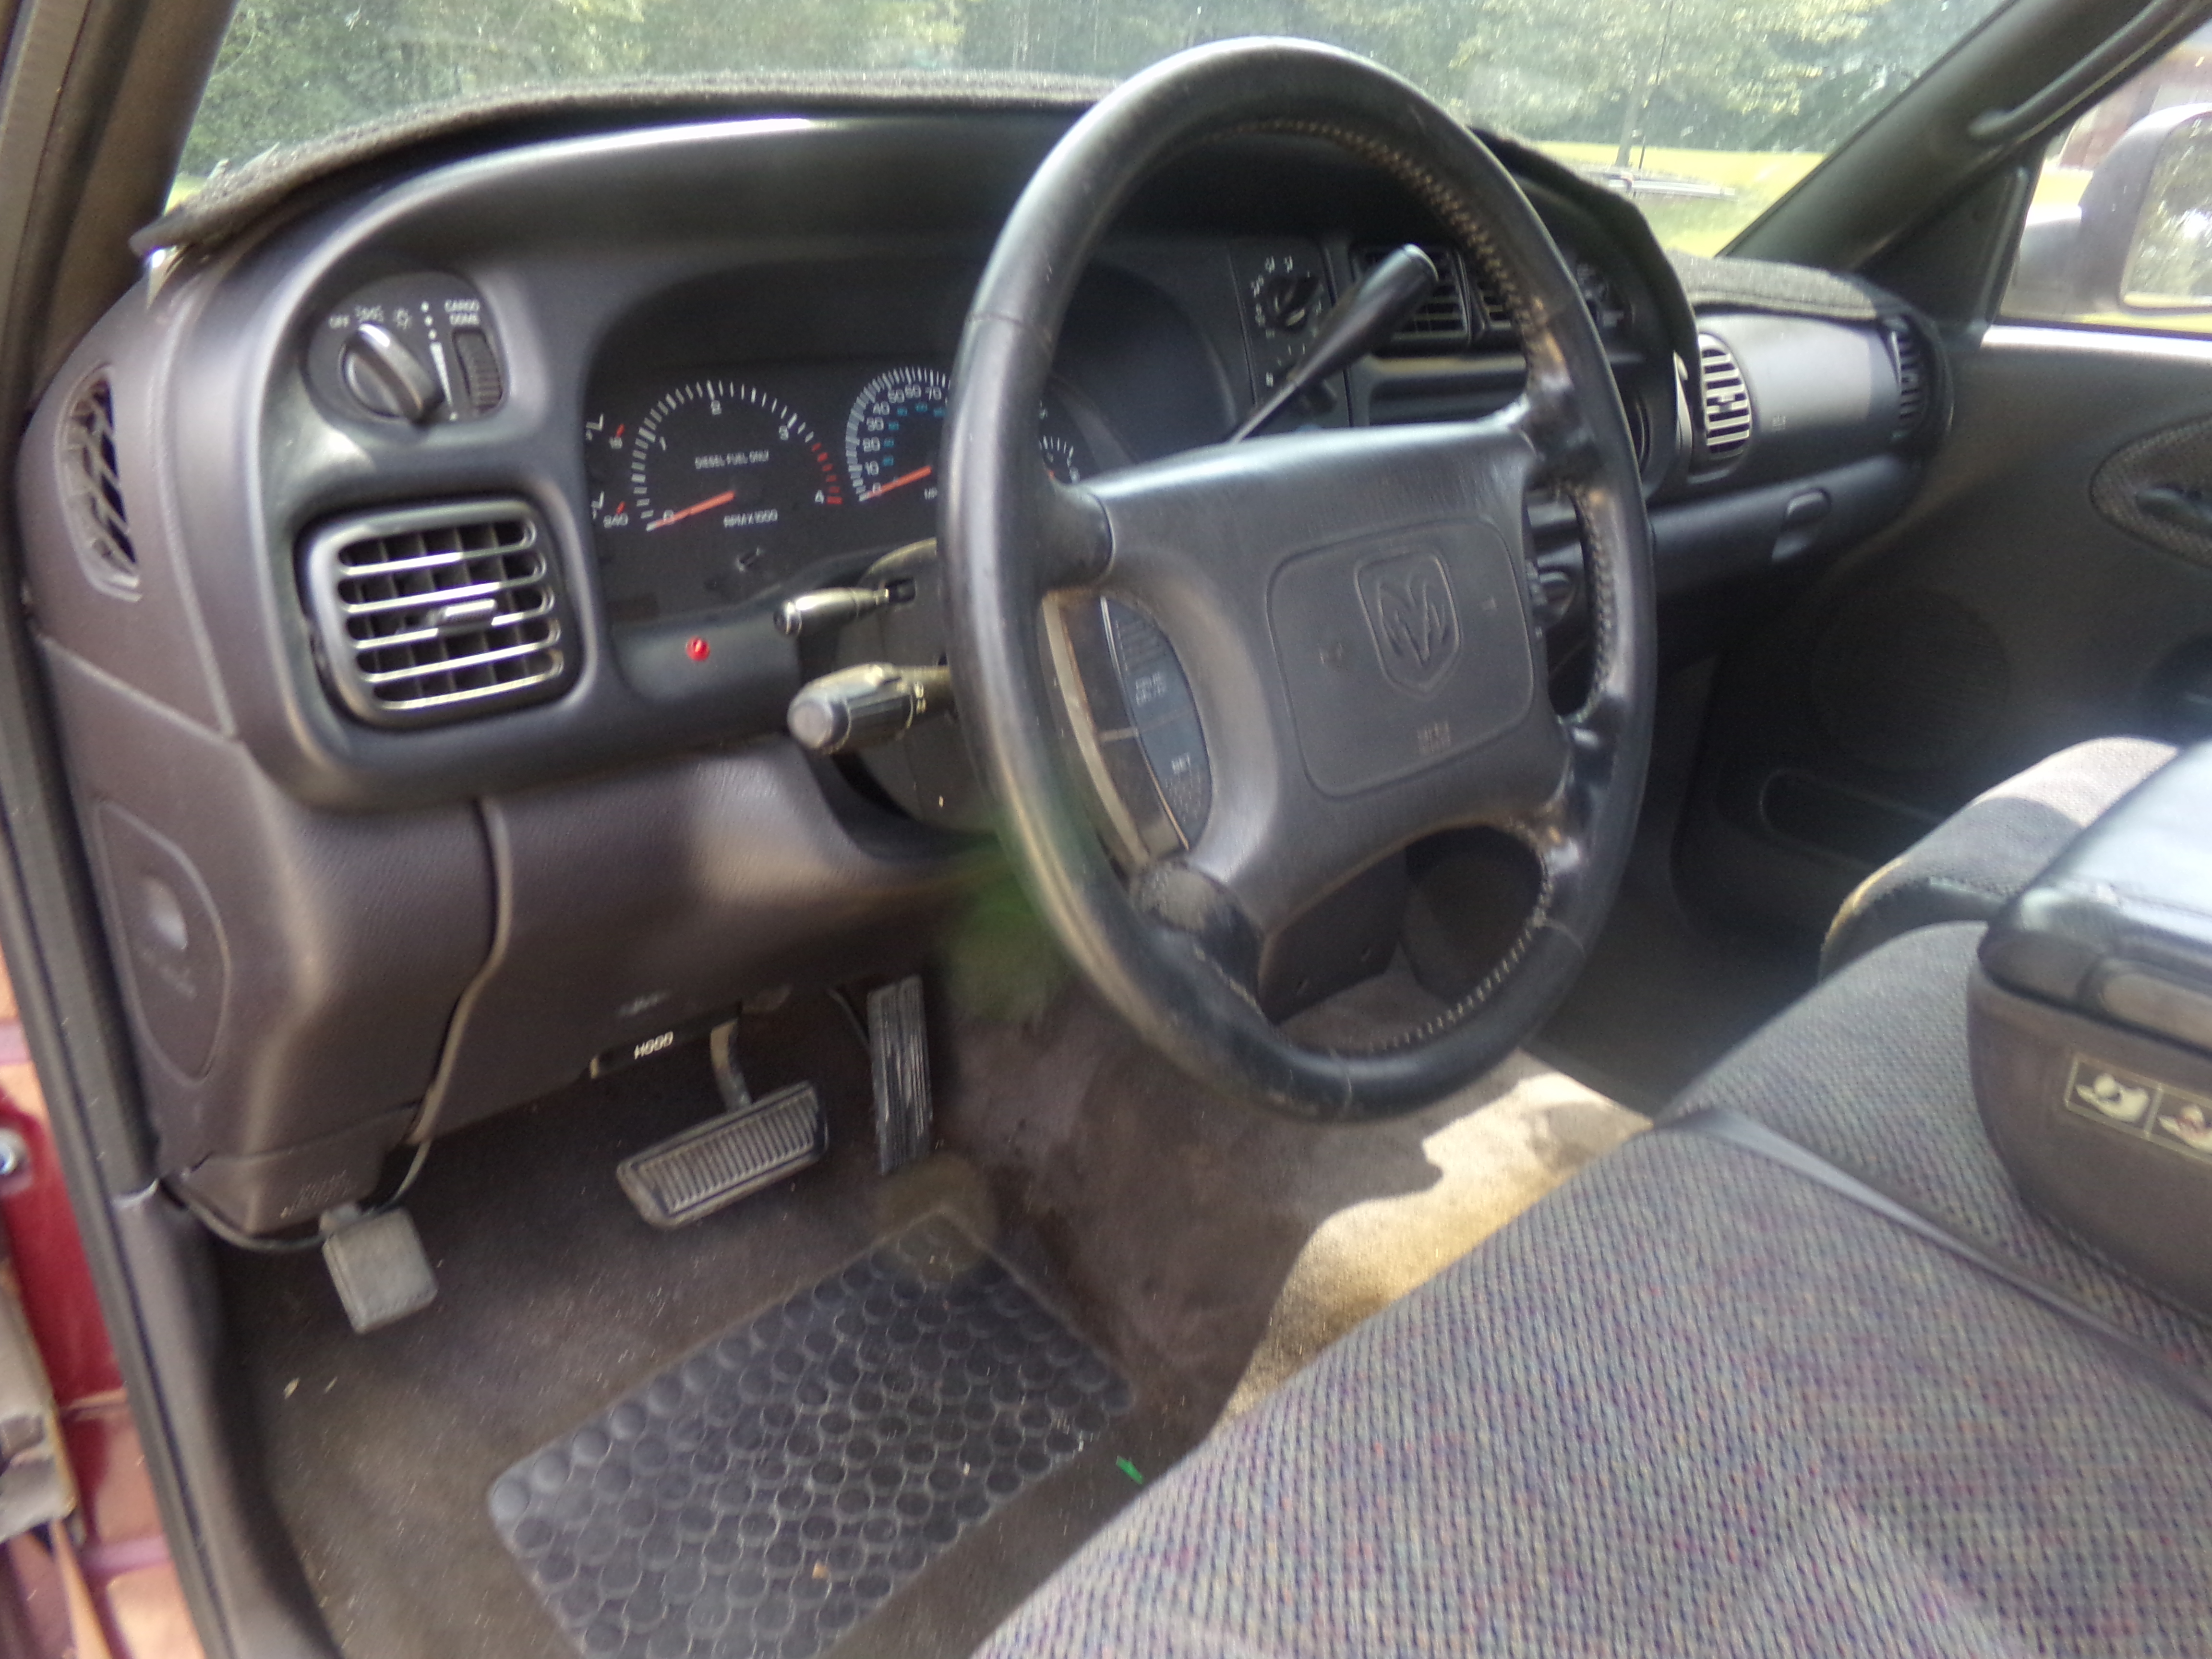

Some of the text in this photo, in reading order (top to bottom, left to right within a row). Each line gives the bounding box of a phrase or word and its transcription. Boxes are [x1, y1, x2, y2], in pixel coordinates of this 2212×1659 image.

[873, 400, 890, 416] 40
[865, 461, 879, 476] 10
[815, 490, 824, 504] 4
[634, 1031, 673, 1059] HOOD
